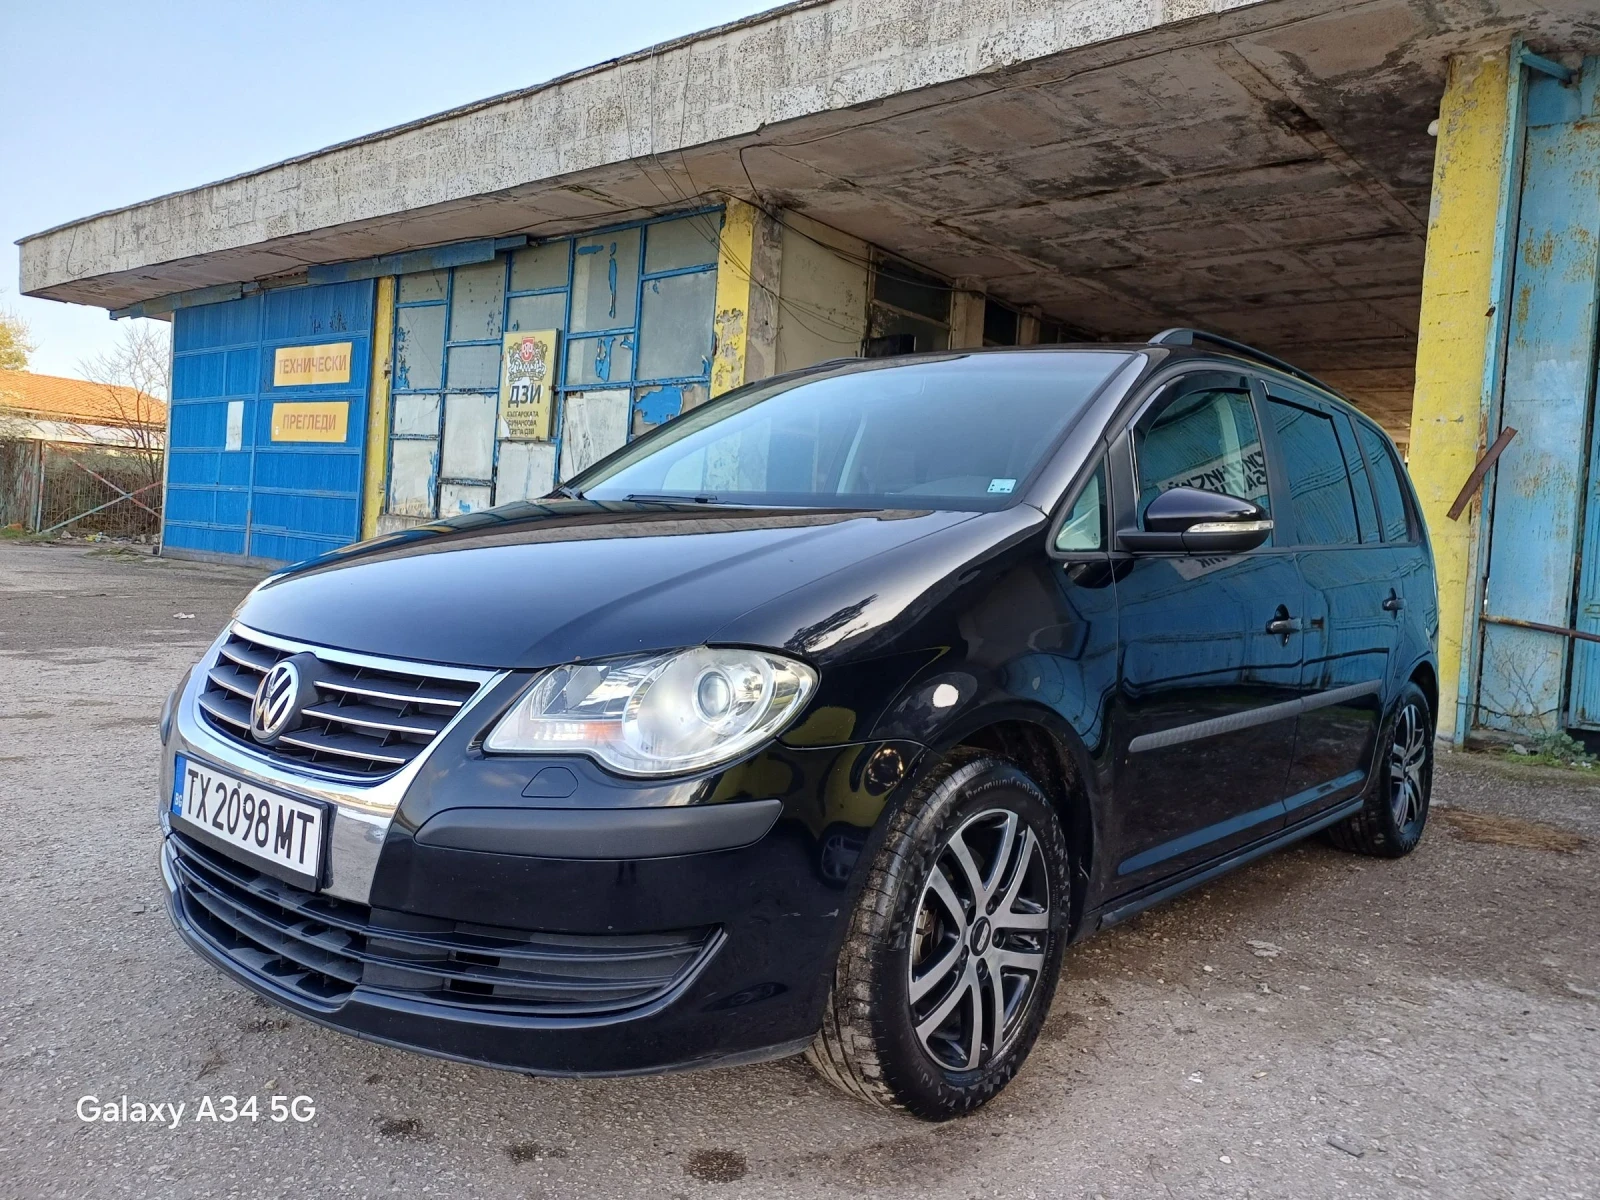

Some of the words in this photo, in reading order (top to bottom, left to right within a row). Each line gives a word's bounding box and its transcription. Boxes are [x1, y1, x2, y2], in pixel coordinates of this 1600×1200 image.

[278, 355, 347, 374] ТЕХНИЧЕСКИ
[507, 383, 541, 408] ДЗИ
[282, 414, 337, 433] ПРЕГЛЕДИ
[174, 792, 183, 808] BG
